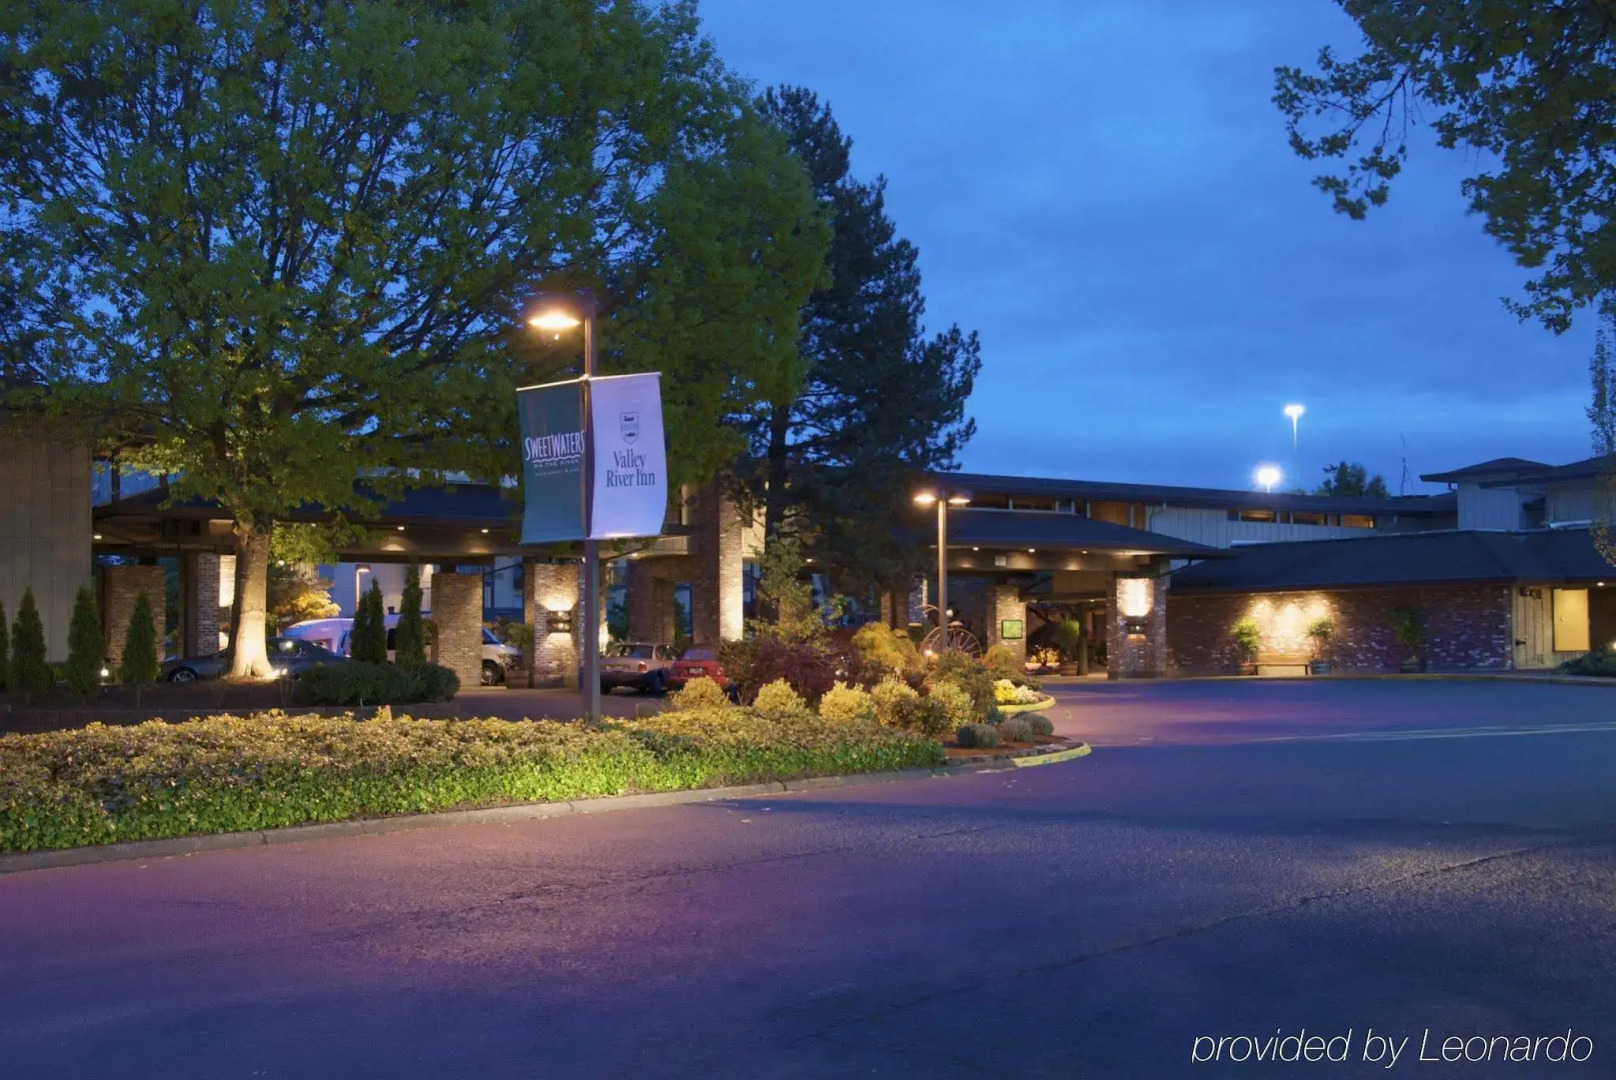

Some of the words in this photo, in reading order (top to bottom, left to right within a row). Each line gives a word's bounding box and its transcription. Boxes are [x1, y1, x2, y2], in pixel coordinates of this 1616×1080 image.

[613, 449, 646, 473] Valley
[606, 470, 634, 487] River
[636, 468, 655, 486] Inn
